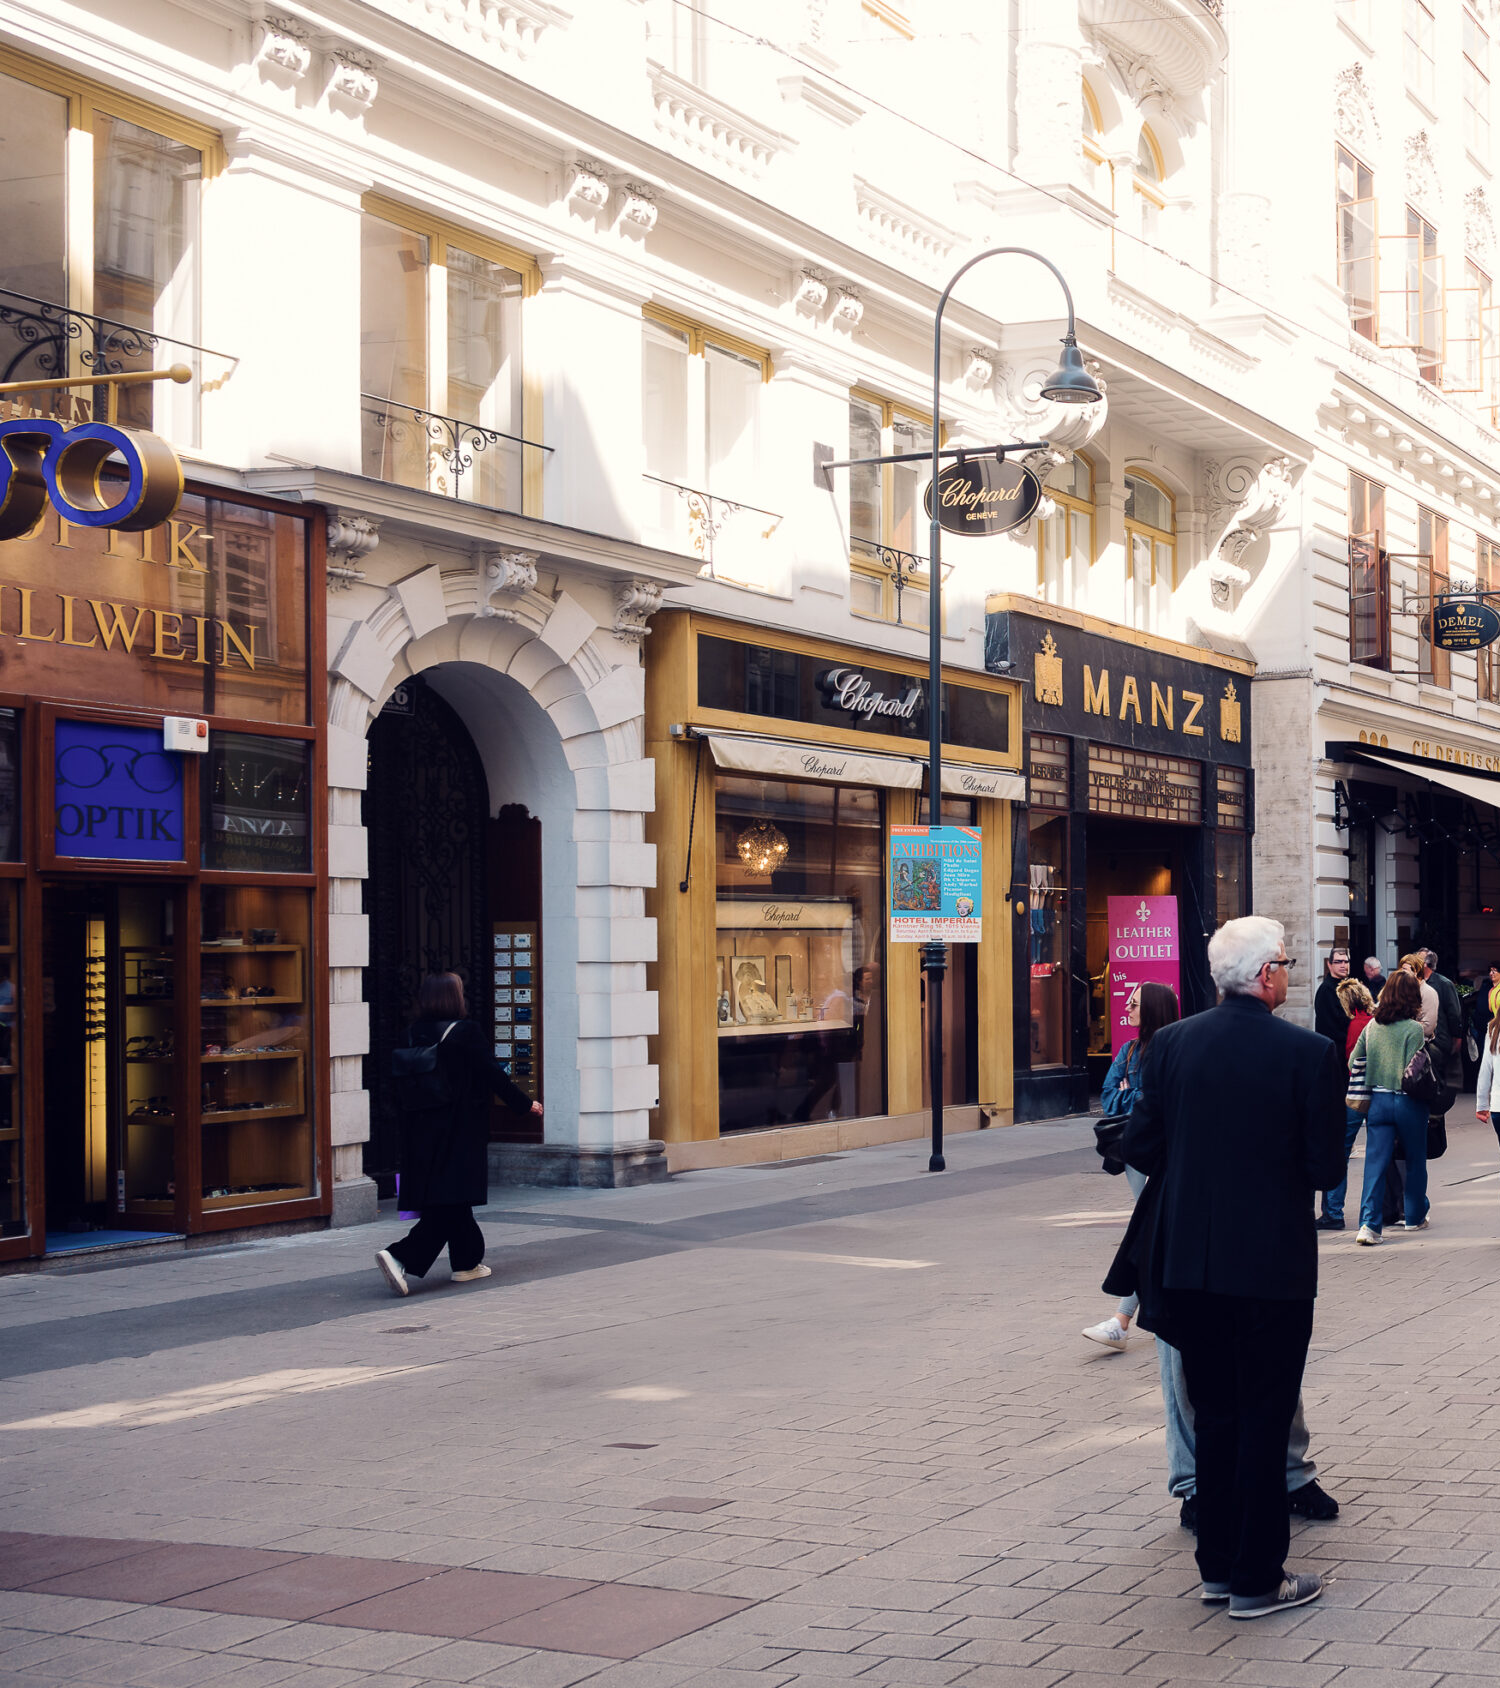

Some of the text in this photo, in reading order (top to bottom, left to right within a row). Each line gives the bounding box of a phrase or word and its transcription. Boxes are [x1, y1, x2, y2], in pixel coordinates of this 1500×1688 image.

[938, 474, 1027, 511] Chopard
[18, 510, 211, 575] PIK
[1438, 615, 1485, 629] DEMEL
[827, 668, 922, 721] Chopard
[1083, 663, 1205, 737] MANZ
[800, 754, 847, 777] Chopard
[960, 775, 998, 794] Chopard
[55, 803, 178, 842] OPTIK
[893, 843, 980, 857] EXHIBITIONS
[761, 904, 804, 925] Chopard
[1116, 926, 1172, 939] LEATHER
[1115, 944, 1173, 959] OUTLET
[1112, 971, 1127, 982] bis
